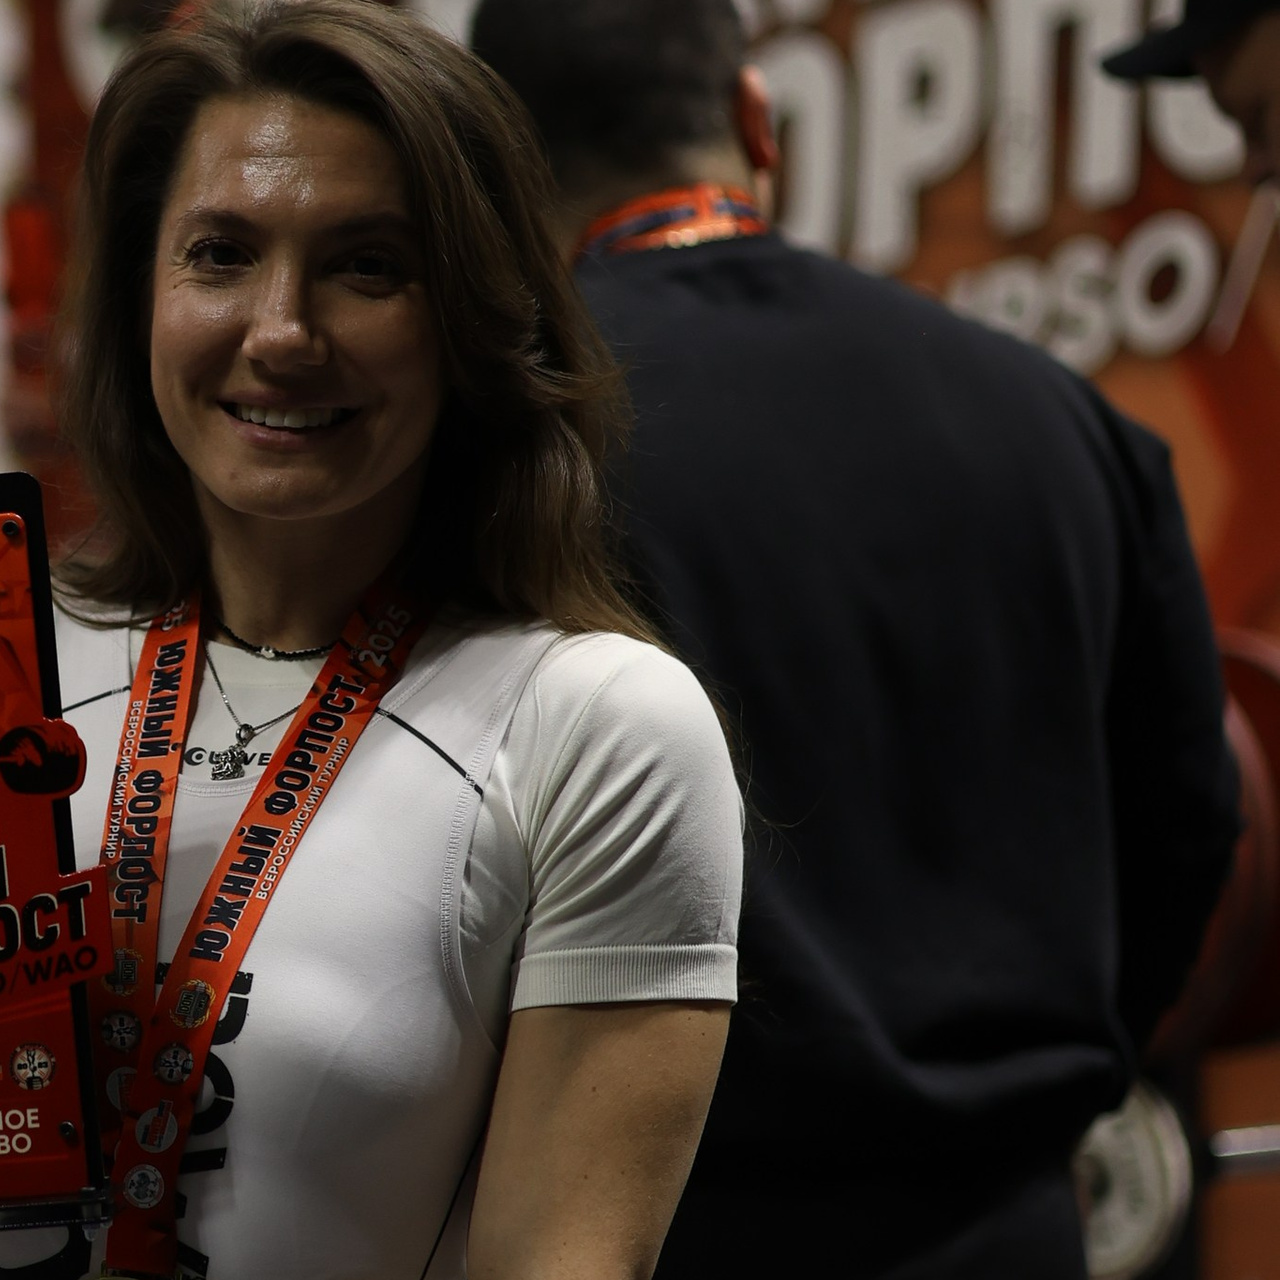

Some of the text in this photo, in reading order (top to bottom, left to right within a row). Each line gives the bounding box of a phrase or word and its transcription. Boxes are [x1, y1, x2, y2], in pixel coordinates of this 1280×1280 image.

[136, 639, 187, 759] ЮЖНЫЙ
[105, 700, 143, 860] ВСЕРОССИЙСКИЙ ТУРНИР
[113, 769, 165, 924] ФОРПОСТ
[189, 824, 284, 963] ЮЖНЫЙ
[264, 674, 368, 816] ФОРПОСТ
[256, 737, 350, 900] ВСЕРОССИЙСКИЙ ТУРНИР
